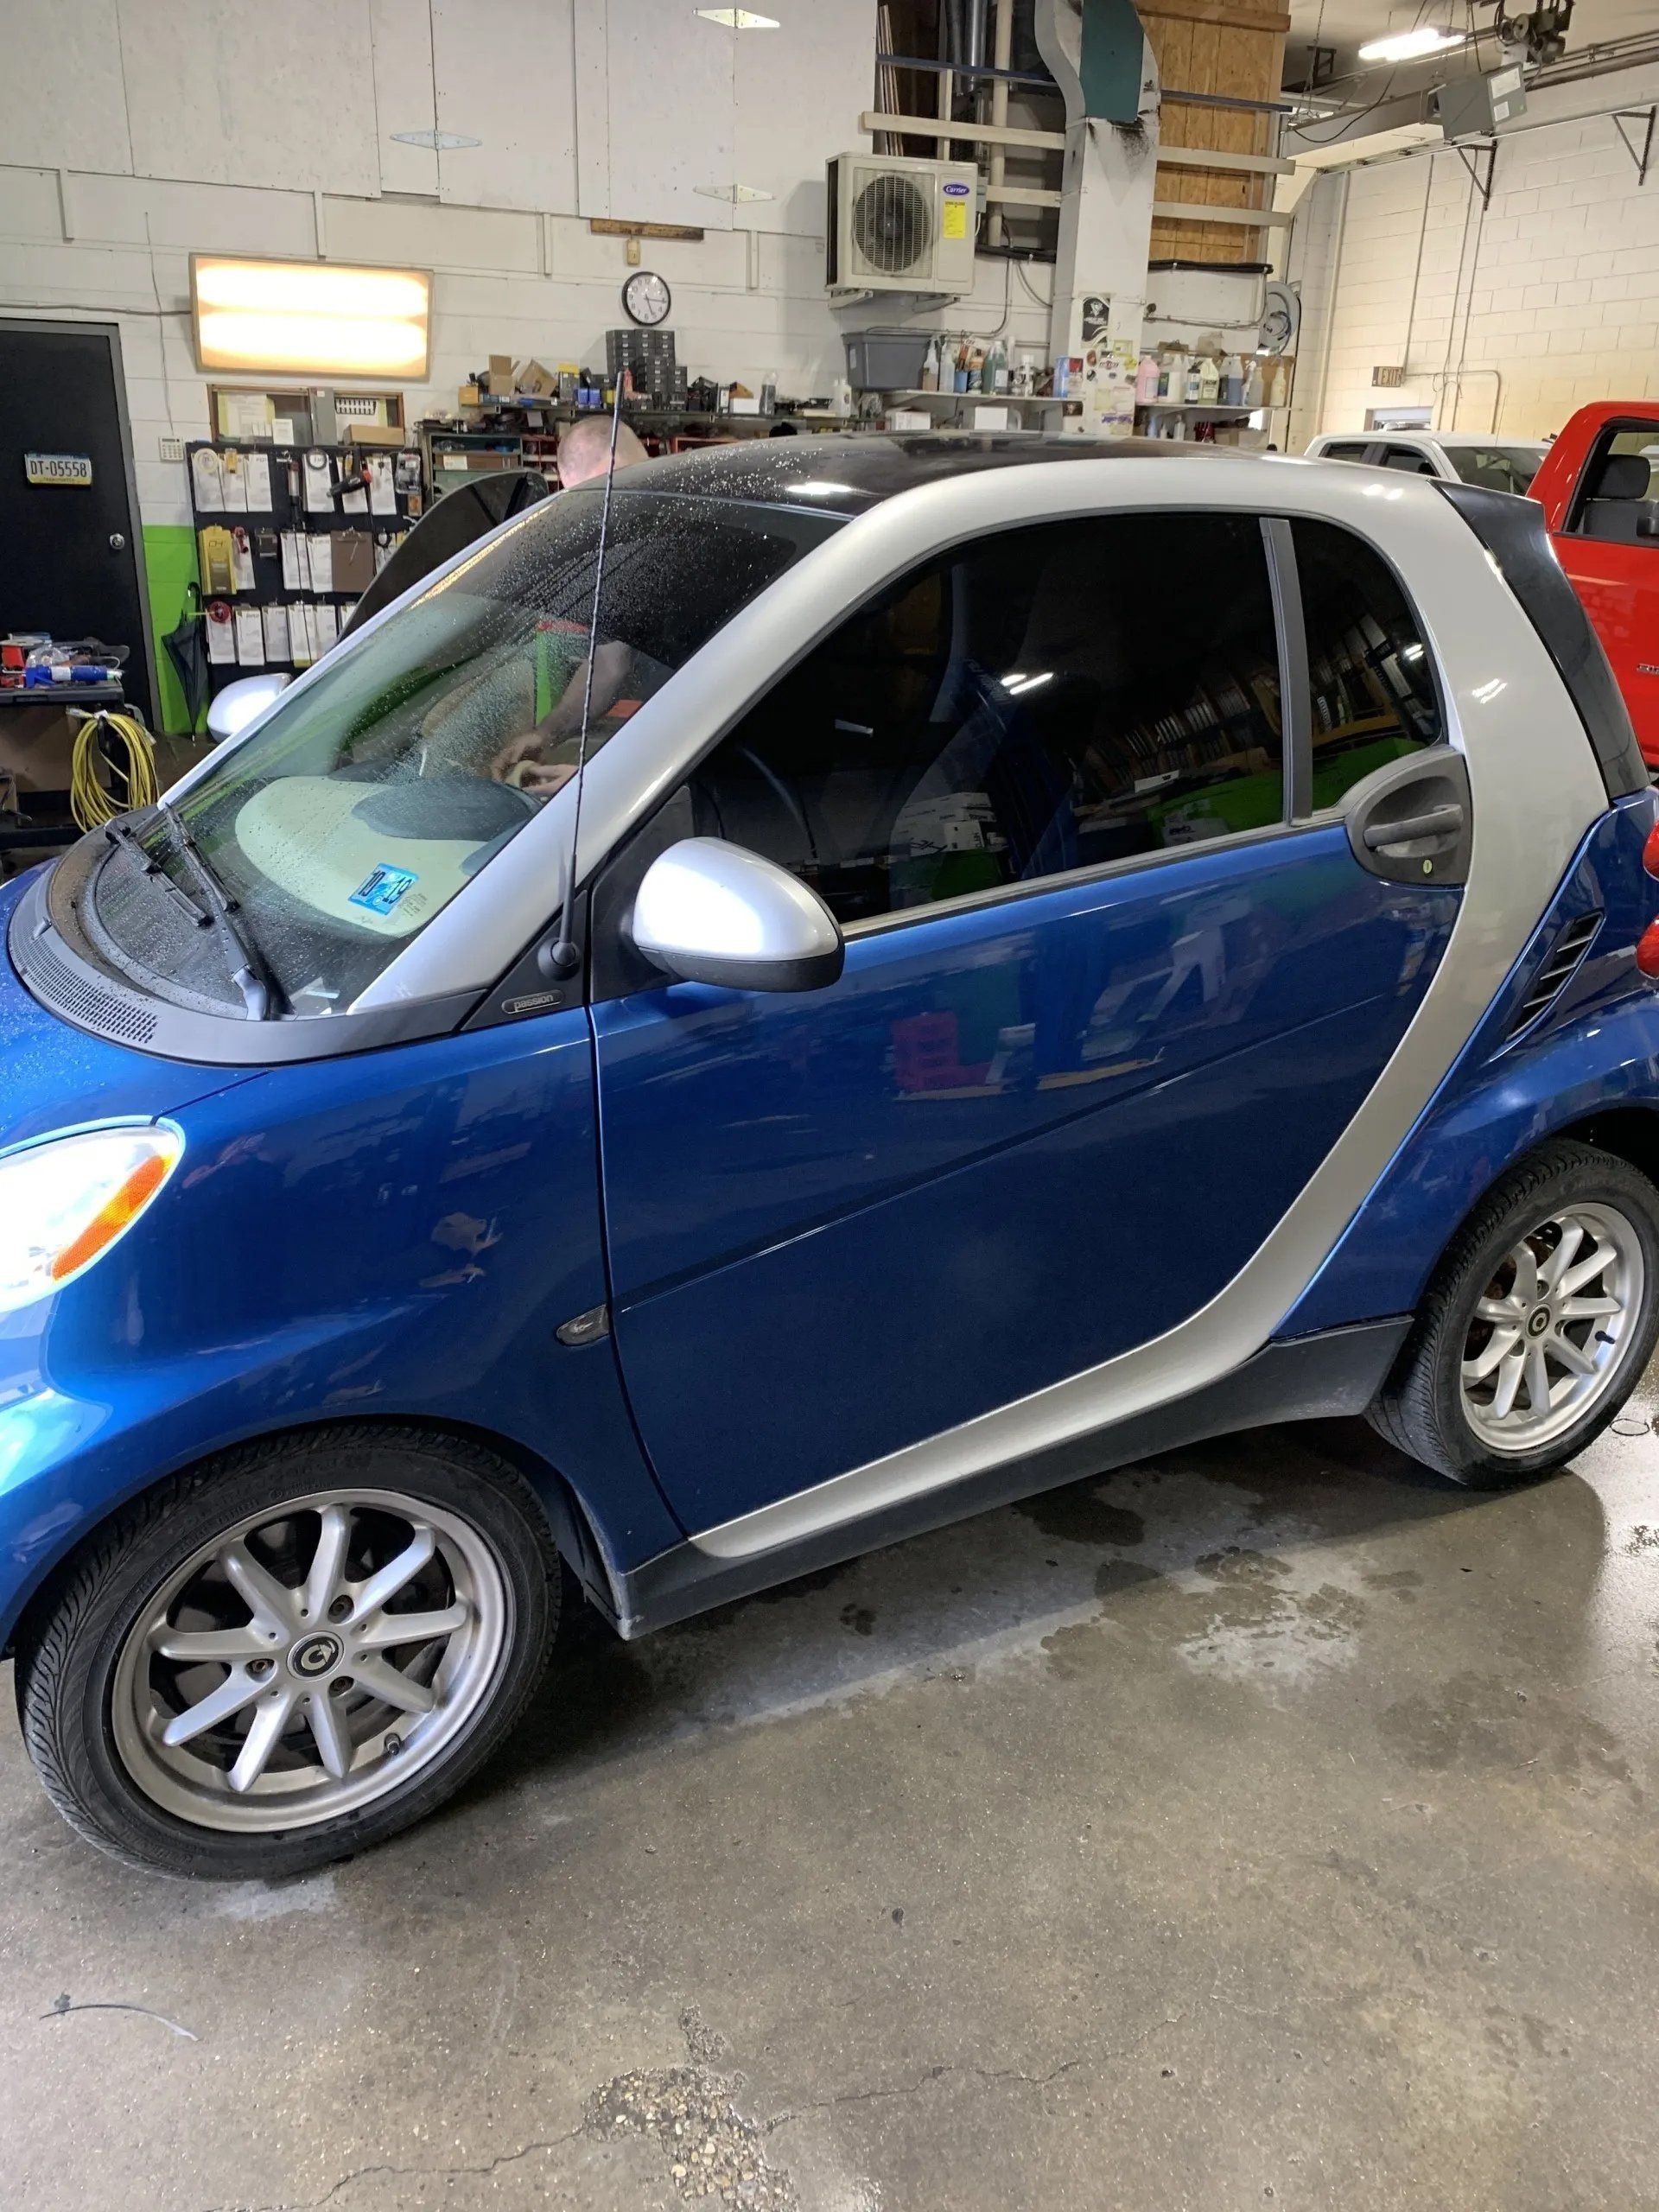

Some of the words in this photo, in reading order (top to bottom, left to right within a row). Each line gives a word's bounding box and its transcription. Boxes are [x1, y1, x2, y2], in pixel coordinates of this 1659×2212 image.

[945, 185, 967, 194] Carrier
[1382, 367, 1401, 385] EXIT
[29, 460, 87, 478] DT-05558
[382, 876, 412, 904] 19
[513, 995, 554, 1012] passion
